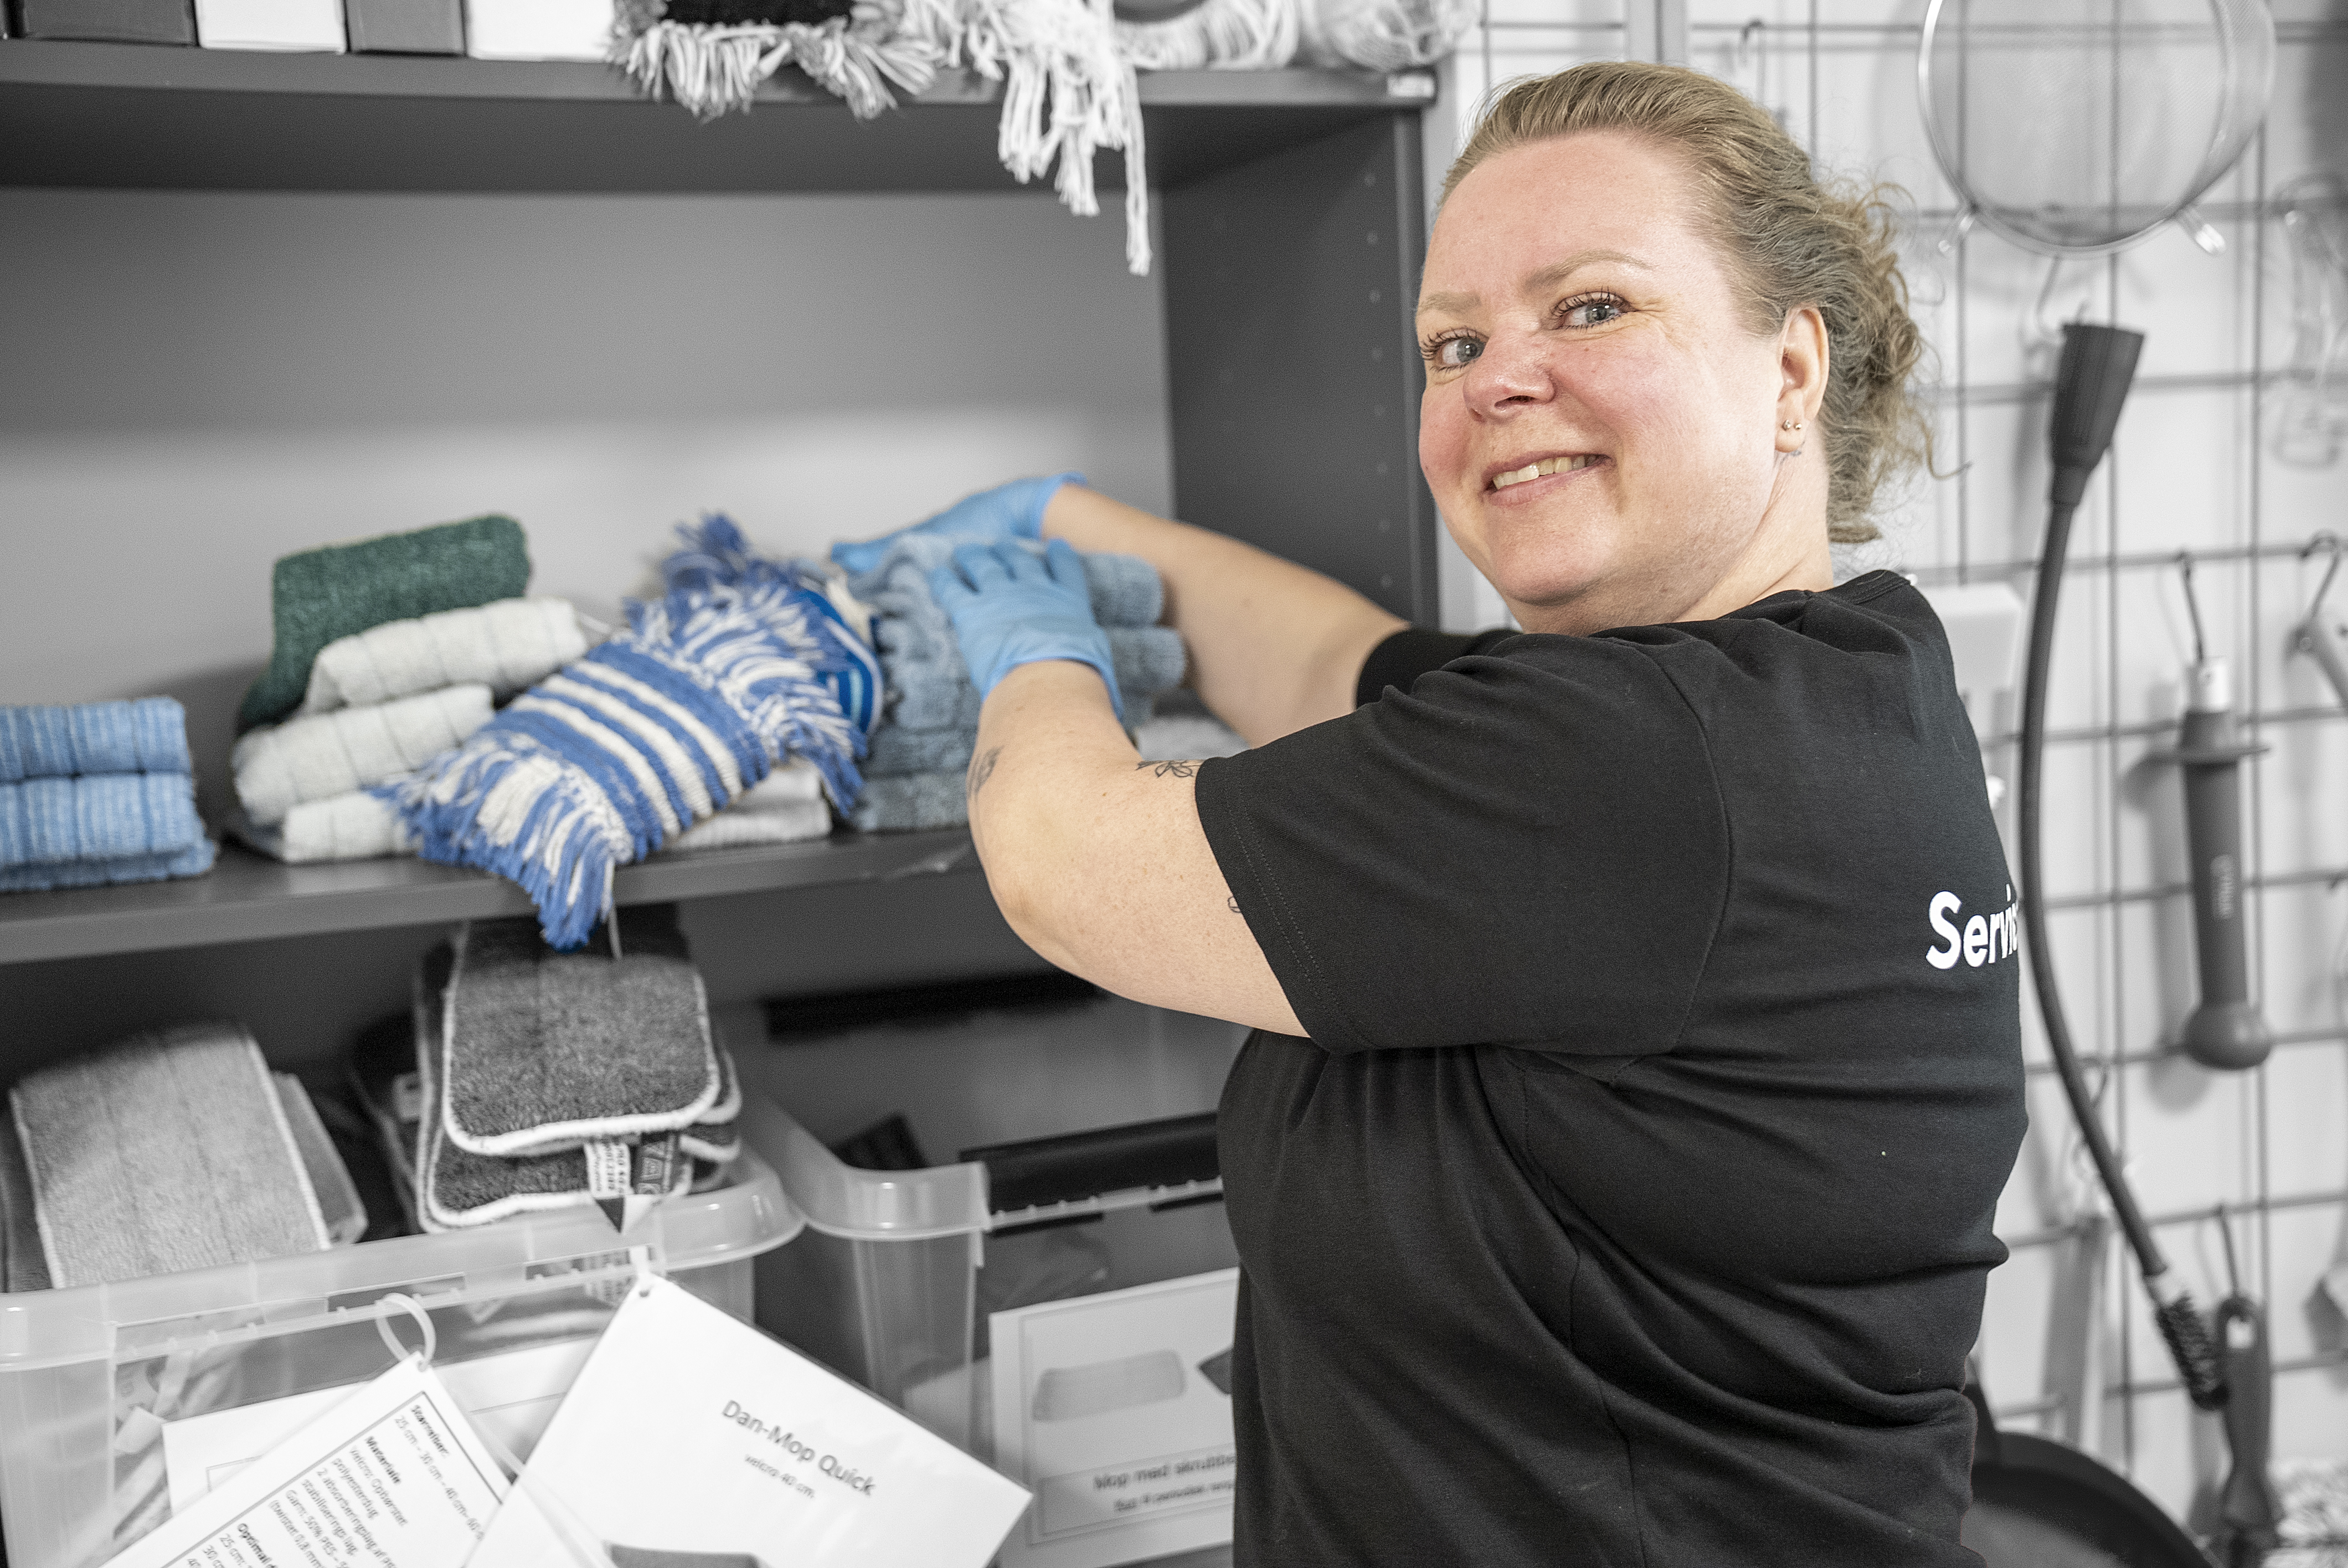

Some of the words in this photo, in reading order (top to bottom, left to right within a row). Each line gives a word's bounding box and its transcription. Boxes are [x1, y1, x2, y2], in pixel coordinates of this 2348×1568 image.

[366, 1436, 401, 1484] Materiale
[394, 1416, 409, 1430] 25
[404, 1430, 418, 1445] cm
[420, 1452, 433, 1465] 30
[429, 1466, 442, 1481] cm
[445, 1488, 457, 1499] 40
[722, 1400, 815, 1462] Dan-Mop
[818, 1454, 875, 1496] Quick
[203, 1545, 218, 1560] 30
[219, 1534, 235, 1549] 25
[238, 1523, 271, 1564] Optimal
